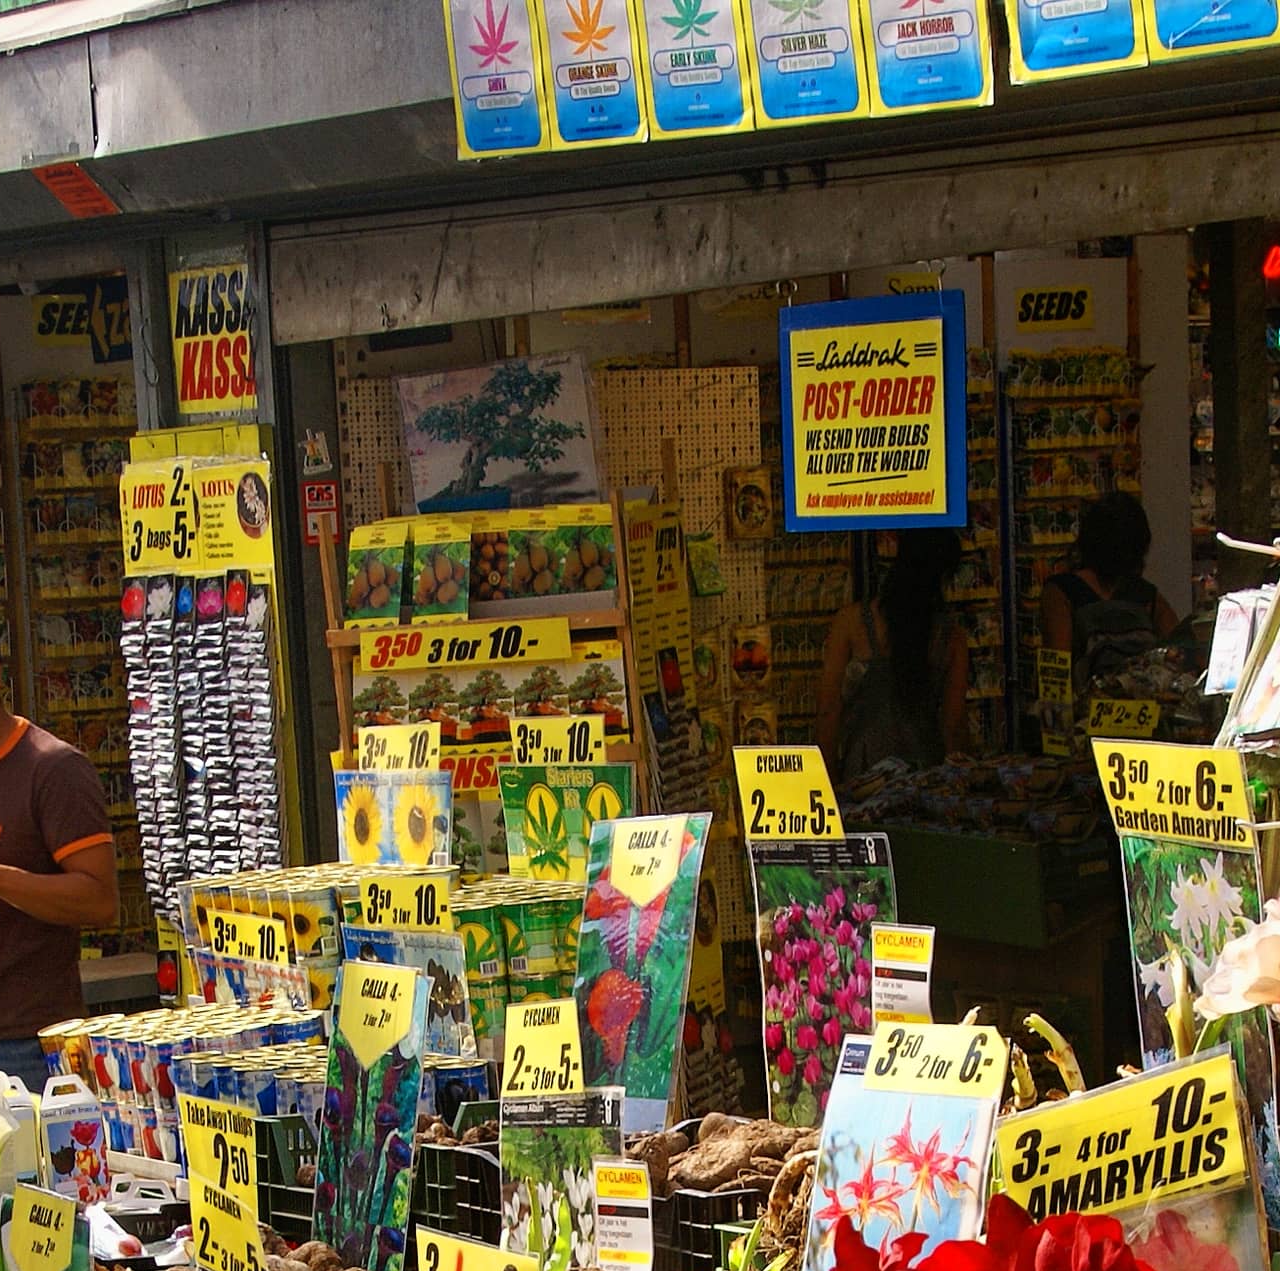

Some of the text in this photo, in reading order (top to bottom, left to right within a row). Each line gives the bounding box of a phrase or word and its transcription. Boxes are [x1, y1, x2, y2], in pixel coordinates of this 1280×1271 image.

[805, 33, 829, 49] HAZE
[1019, 290, 1087, 322] SEEDS
[816, 339, 909, 371] Laddrak
[802, 375, 937, 421] POST-ORDER
[805, 423, 930, 451] WE SEND YOUR BULBS
[825, 449, 930, 474] OVER THE WORLD!
[131, 482, 166, 510] LOTUS
[201, 479, 236, 499] LOTUS
[146, 526, 172, 552] bags
[370, 625, 539, 667] 3.50 3 for 10.-
[567, 721, 603, 762] 10.-
[756, 754, 804, 773] CYCLAMEN
[1108, 752, 1233, 812] 3.50 for 6.-
[787, 789, 837, 835] for 5.-
[1114, 806, 1247, 843] Garden Amaryllis
[628, 831, 659, 851] CALLA
[367, 882, 448, 925] 3.50 10.-
[214, 914, 286, 962] 3.50 10.-
[875, 933, 925, 950] CYCLAMEN
[523, 1006, 560, 1027] CYCLAMEN
[874, 1027, 995, 1083] 3.50 for 6.-
[1011, 1076, 1227, 1184] 3.- for 10.-
[597, 1169, 642, 1185] CYCLAMEN
[1025, 1126, 1228, 1224] AMARYLLIS
[29, 1203, 54, 1229] CALLA
